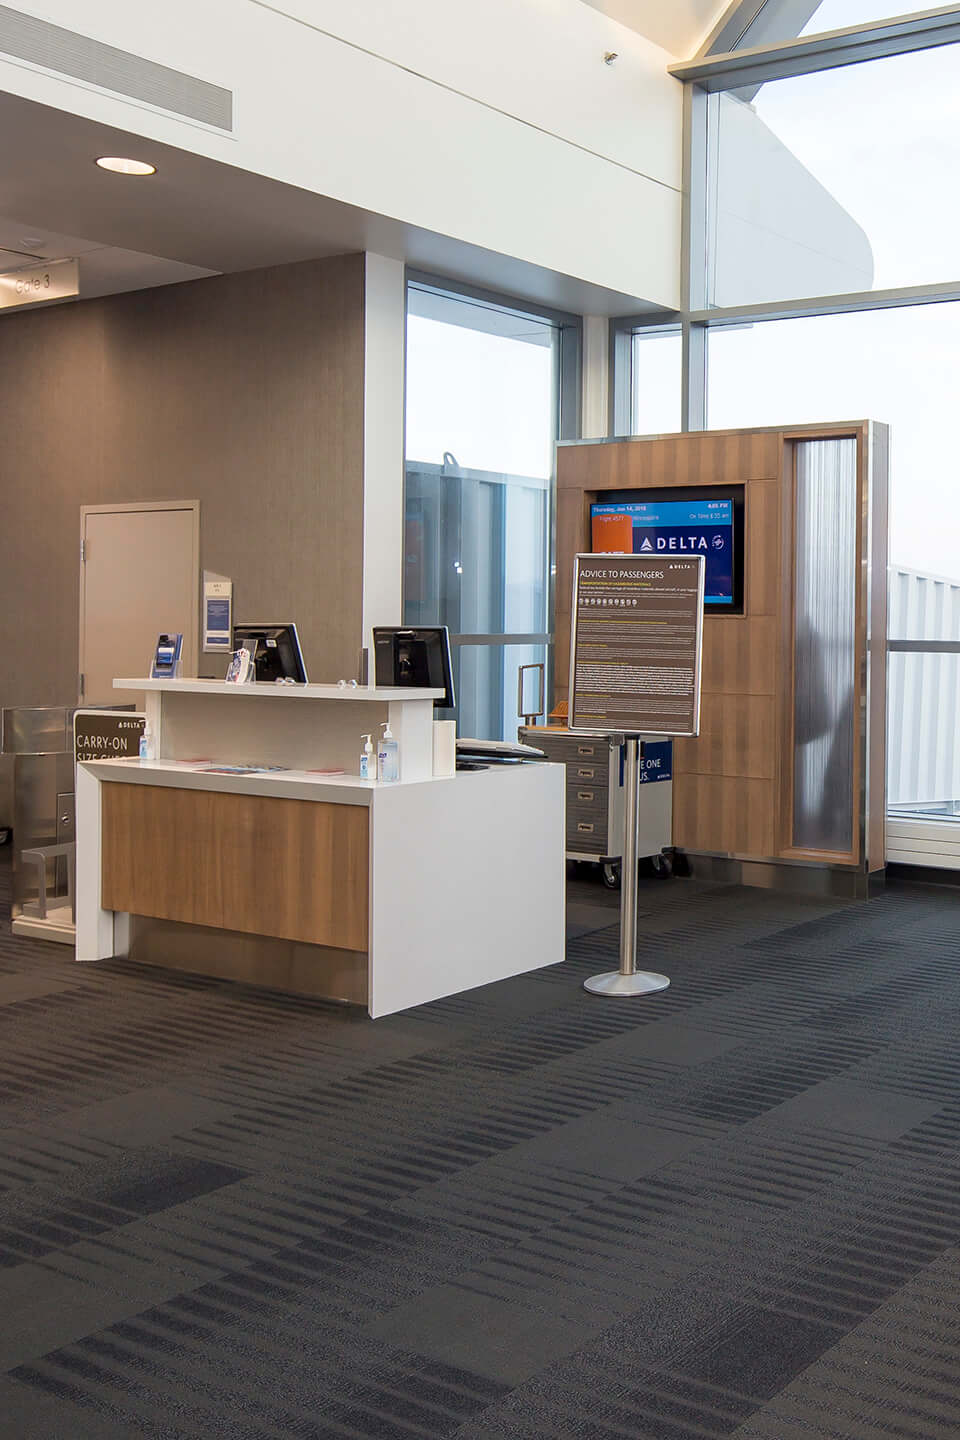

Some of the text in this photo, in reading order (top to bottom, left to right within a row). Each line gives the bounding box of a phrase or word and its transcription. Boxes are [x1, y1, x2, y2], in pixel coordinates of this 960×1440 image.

[16, 274, 50, 295] Gate 3
[656, 536, 708, 549] DELTA
[580, 570, 664, 579] ADVICE TO PASSENGERS
[76, 735, 128, 750] CARRY-ON
[646, 758, 662, 768] ONE
